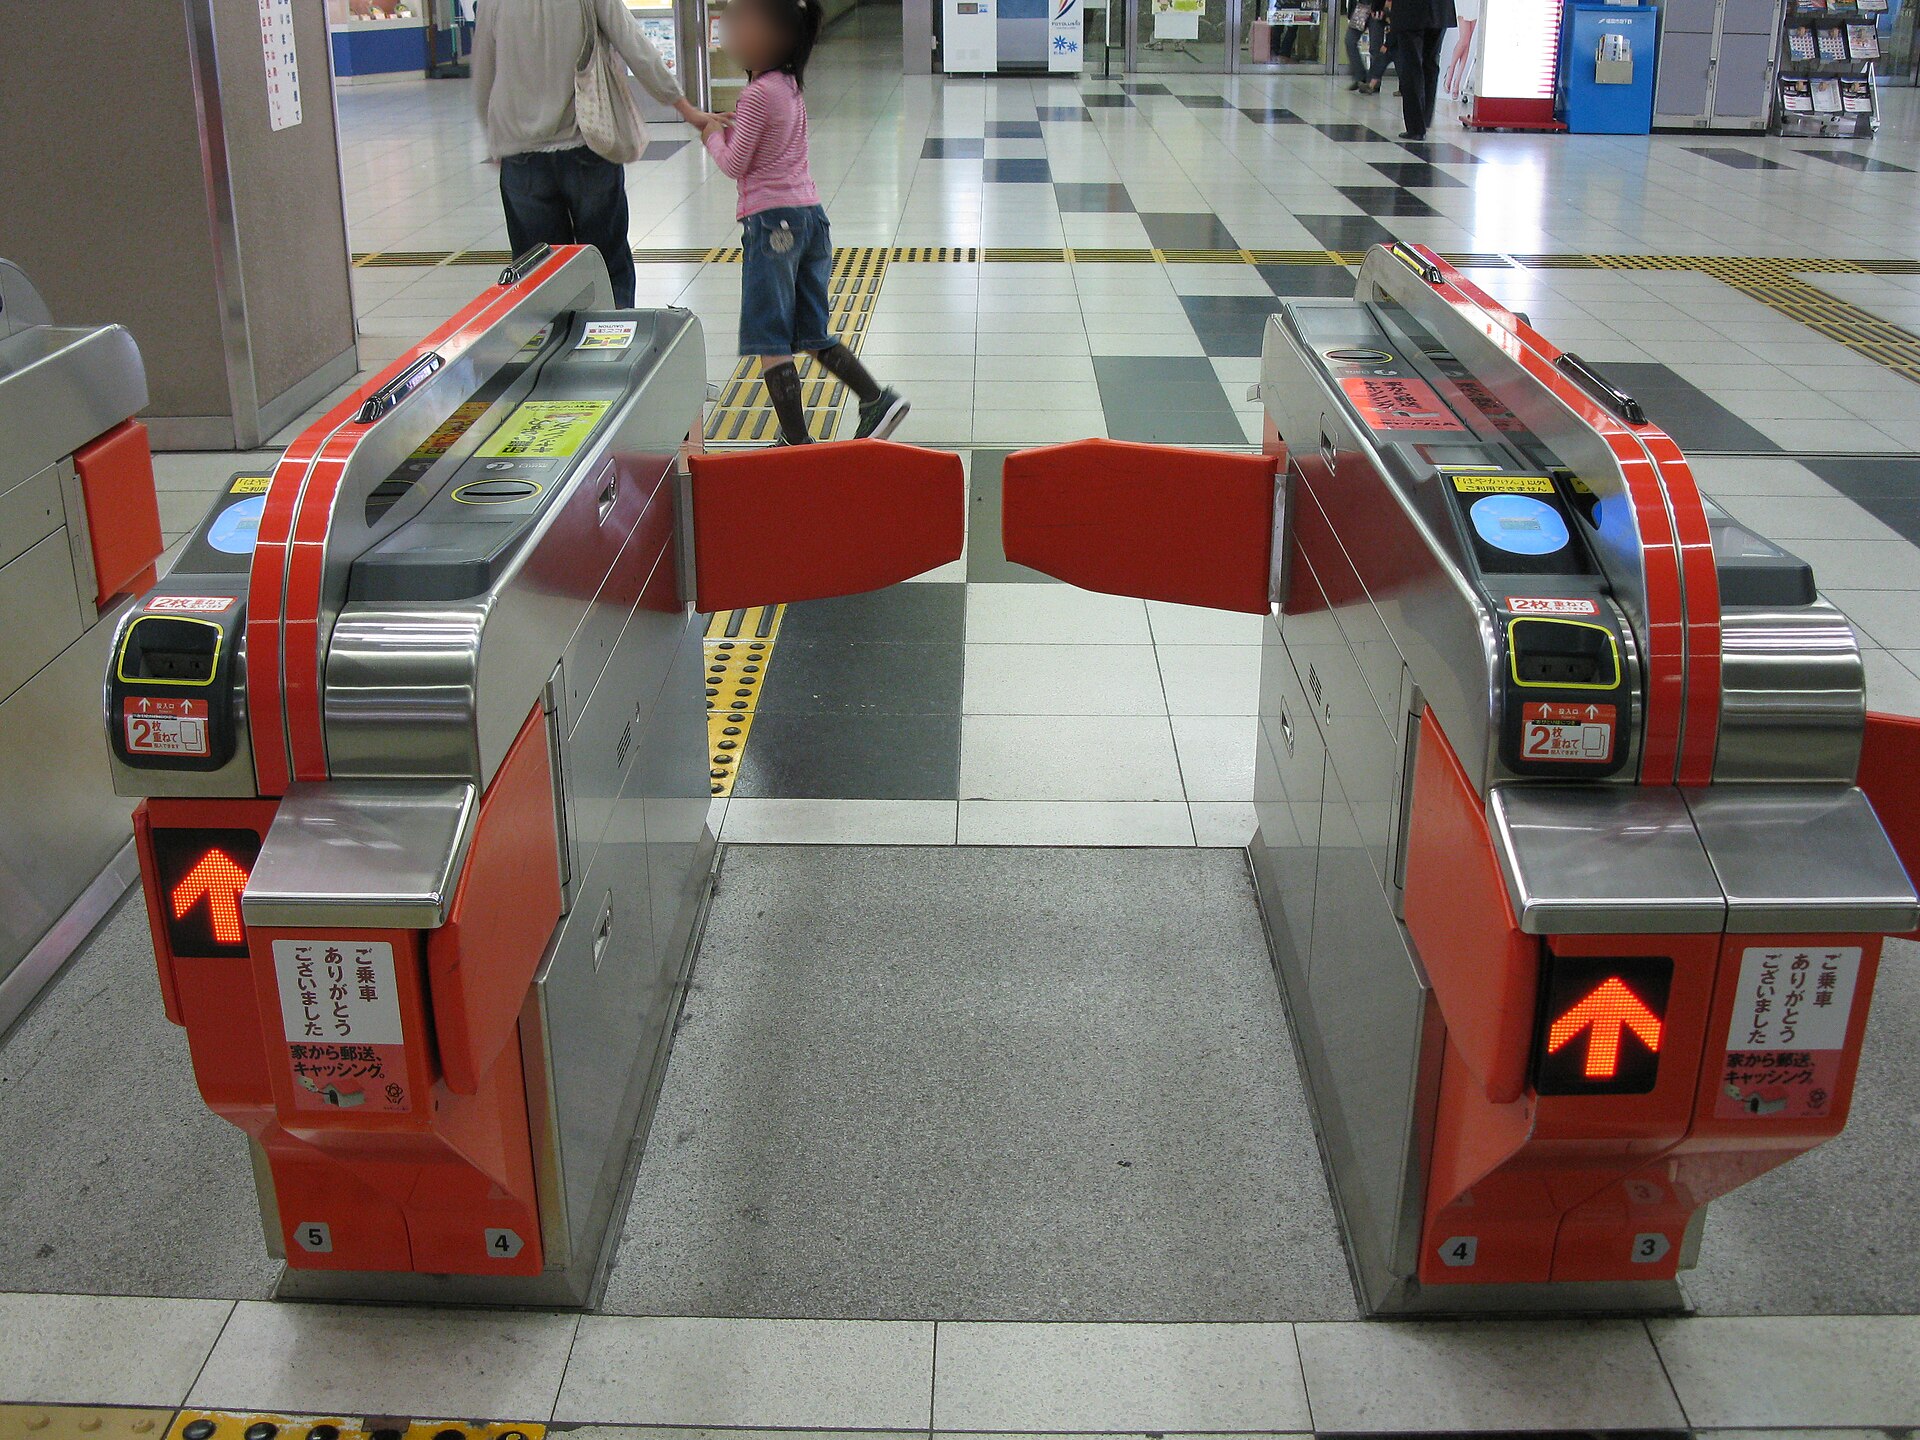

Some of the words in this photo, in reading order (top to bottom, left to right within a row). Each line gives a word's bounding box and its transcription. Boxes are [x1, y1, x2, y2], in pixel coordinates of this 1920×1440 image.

[1456, 477, 1547, 485] 「はやかけん」以外
[1514, 599, 1550, 610] 2枚
[133, 719, 153, 748] 2
[152, 720, 162, 732] 枚
[1551, 726, 1563, 738] 枚
[153, 731, 178, 743] 重ねて
[1529, 725, 1551, 755] 2
[1551, 738, 1580, 749] 重ねて
[355, 947, 379, 1003] ご乗車
[1813, 953, 1843, 1008] ご乗車
[295, 946, 324, 1037] ございました
[324, 946, 352, 1037] ありがとう
[1747, 953, 1783, 1045] ございました
[1779, 953, 1810, 1044] ありがとう
[290, 1045, 383, 1063] 家から郵送、
[1726, 1053, 1816, 1069] 家から郵送、
[293, 1062, 386, 1080] キャッシング。
[308, 1228, 324, 1246] 5
[494, 1234, 510, 1252] 4
[1452, 1242, 1468, 1260] 4
[1640, 1239, 1656, 1256] 3
